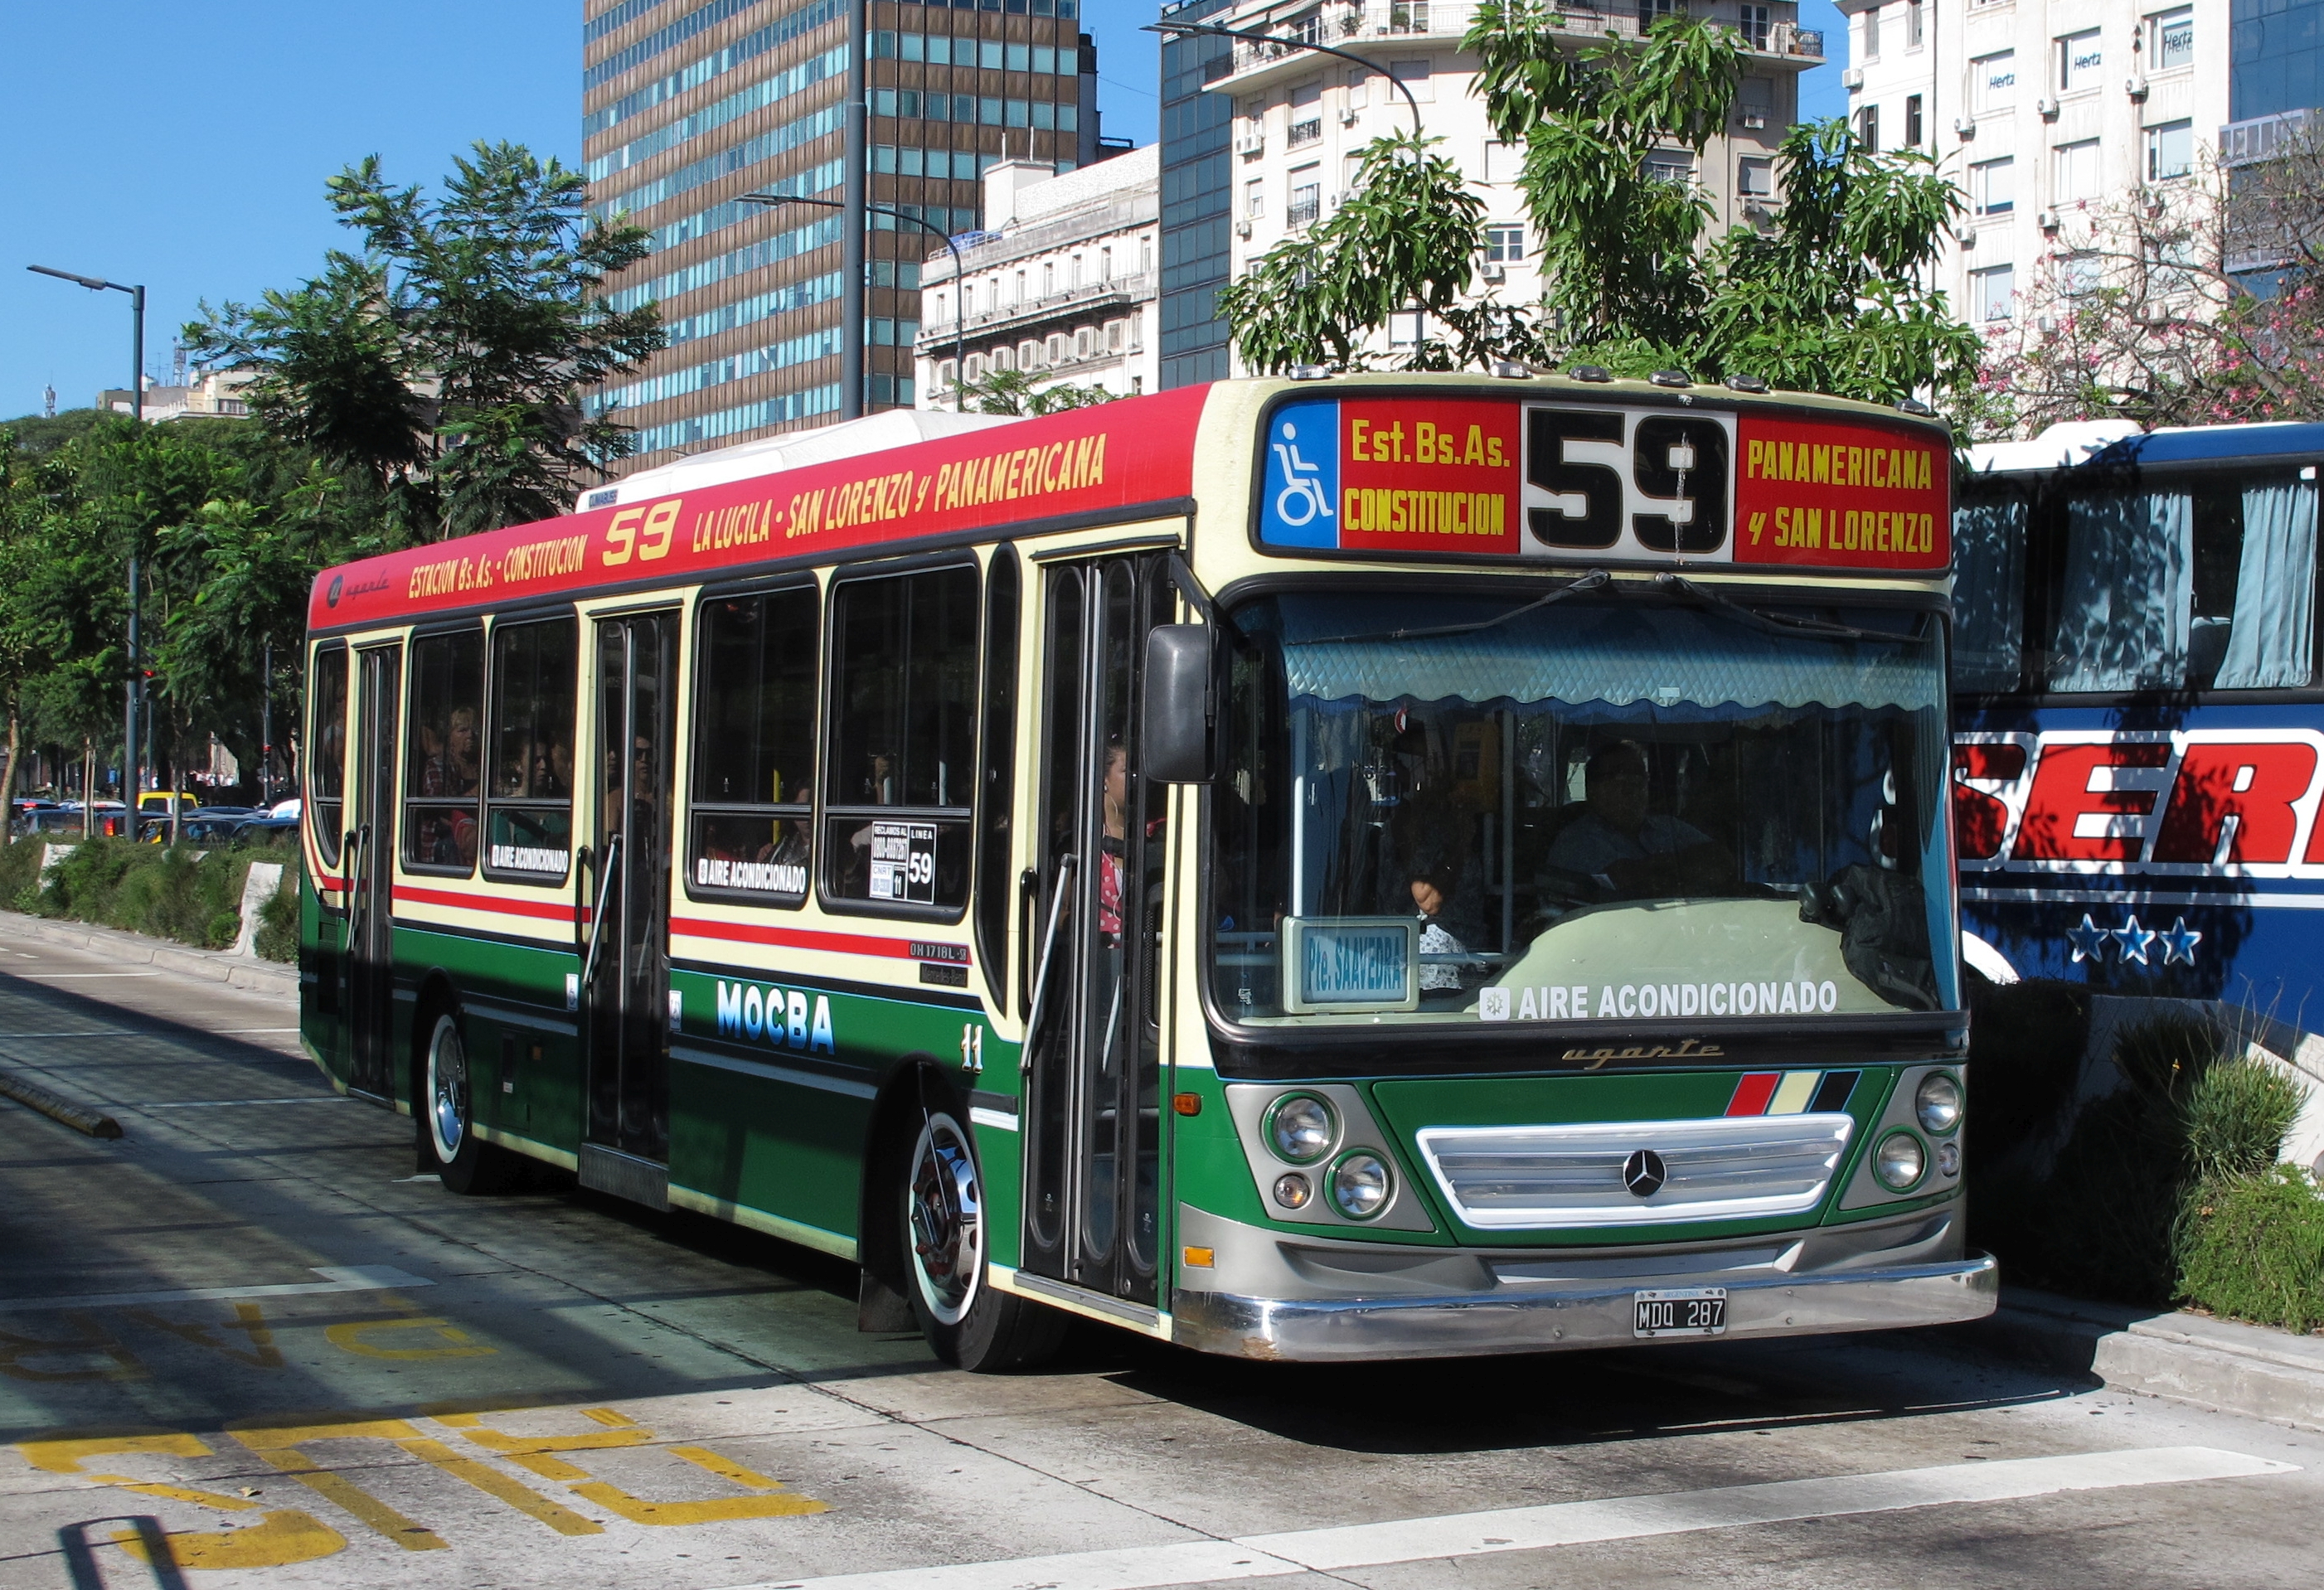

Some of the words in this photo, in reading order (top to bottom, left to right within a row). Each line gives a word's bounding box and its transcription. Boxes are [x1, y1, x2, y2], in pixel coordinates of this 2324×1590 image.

[2165, 31, 2193, 47] Hertz
[1989, 73, 2016, 90] Hertz
[2074, 53, 2102, 70] Hertz
[1526, 407, 1728, 553] 59
[1748, 439, 1933, 491] PANAMERICANA
[693, 511, 714, 553] LA
[715, 499, 773, 550] LUCILA
[786, 487, 822, 539] SAN
[825, 469, 914, 531] LORENZO
[934, 432, 1108, 513] PANAMERICANA
[1344, 487, 1505, 536] CONSTITUCION
[602, 499, 683, 567] 59
[1775, 507, 1821, 550] SAN
[1829, 508, 1933, 554] LORENZO
[408, 557, 458, 599] ESTACION
[502, 534, 588, 584] CONSTITUCION
[910, 829, 933, 840] LINEA
[500, 846, 514, 868] AIRE
[515, 846, 569, 873] ACONDICIONADO
[708, 859, 730, 885] AIRE
[730, 861, 806, 894] ACONDICIONADO
[909, 851, 932, 884] 59
[895, 875, 902, 895] 11
[1308, 938, 1332, 991] Pte.
[1335, 936, 1401, 991] SAAVEDRA
[716, 980, 836, 1054] MOCBA
[1518, 985, 1589, 1020] AIRE
[1598, 980, 1837, 1018] ACONDICIONADO
[959, 1022, 983, 1074] 11
[1561, 1038, 1725, 1070] ugarte
[1638, 1302, 1673, 1328] MDQ
[1687, 1301, 1723, 1326] 287
